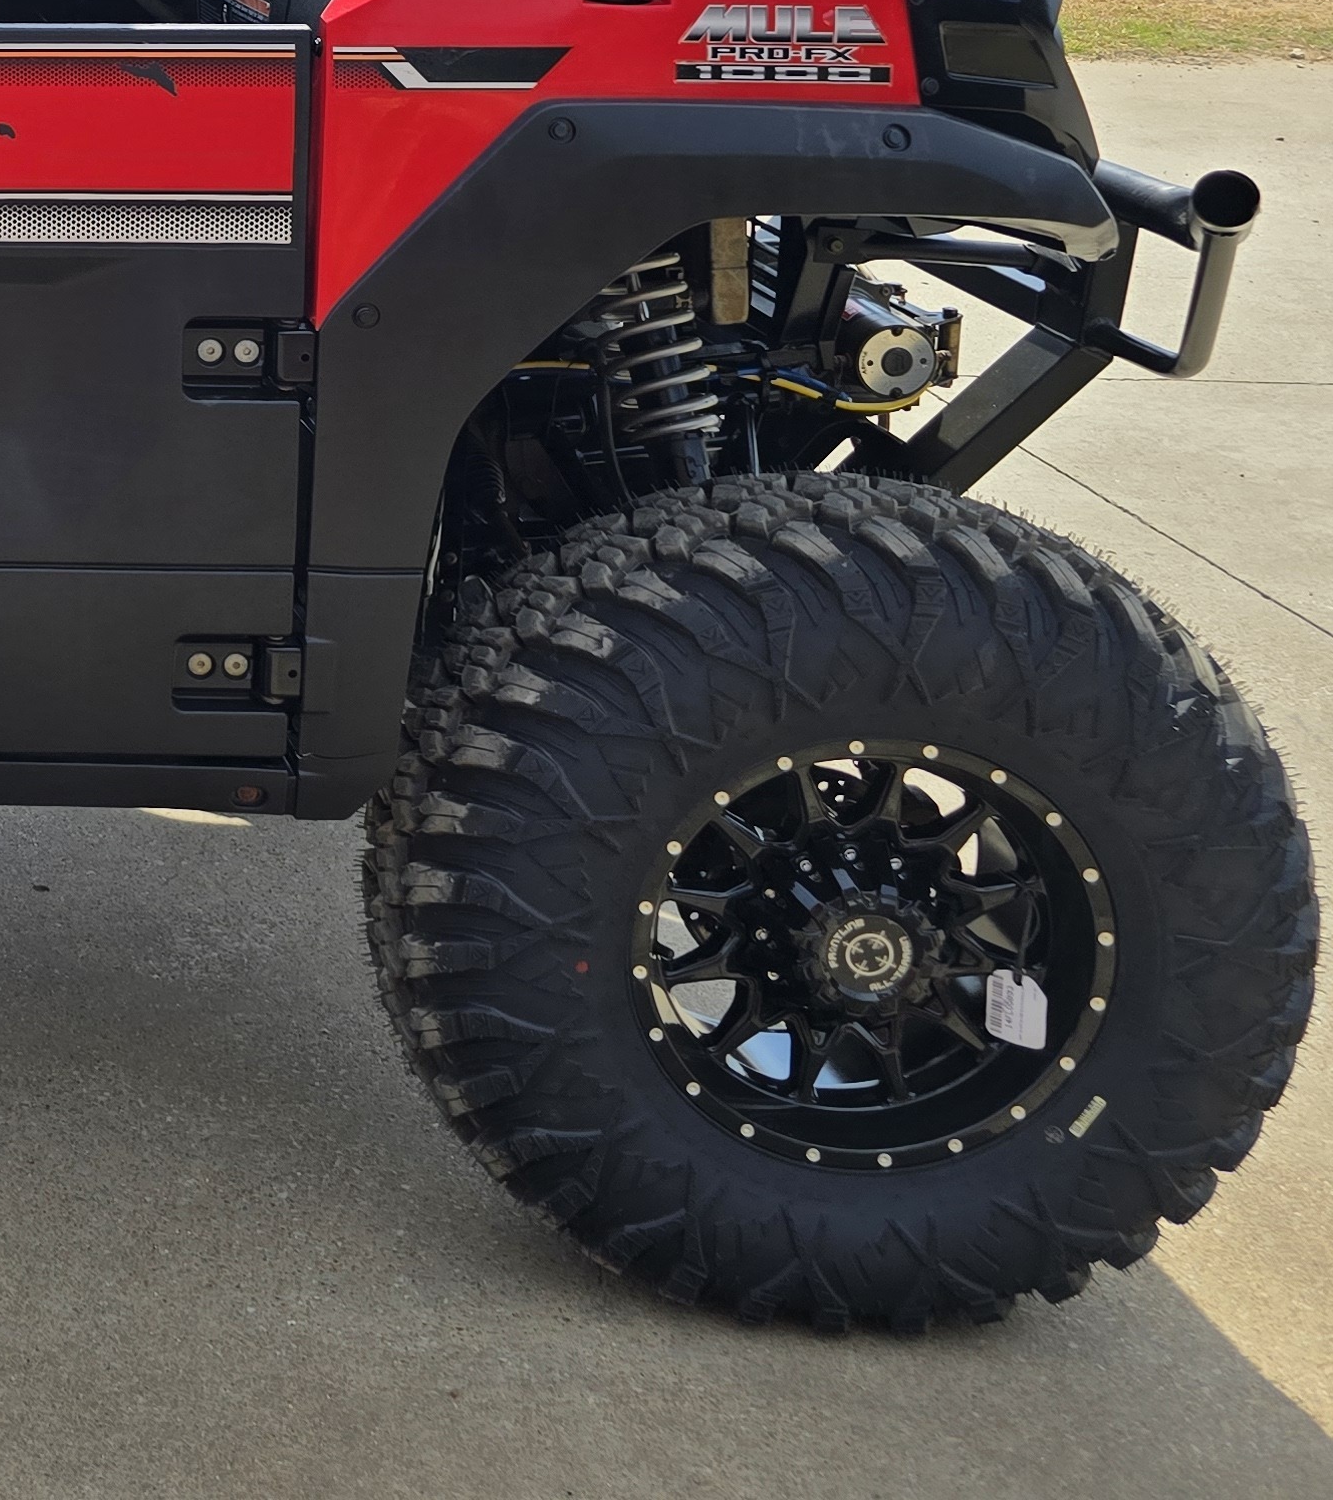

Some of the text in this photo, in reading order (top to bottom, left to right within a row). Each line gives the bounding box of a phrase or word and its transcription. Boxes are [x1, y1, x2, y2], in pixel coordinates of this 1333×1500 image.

[679, 4, 888, 45] MULE
[706, 46, 860, 62] PRO-FX
[695, 65, 871, 82] 1000
